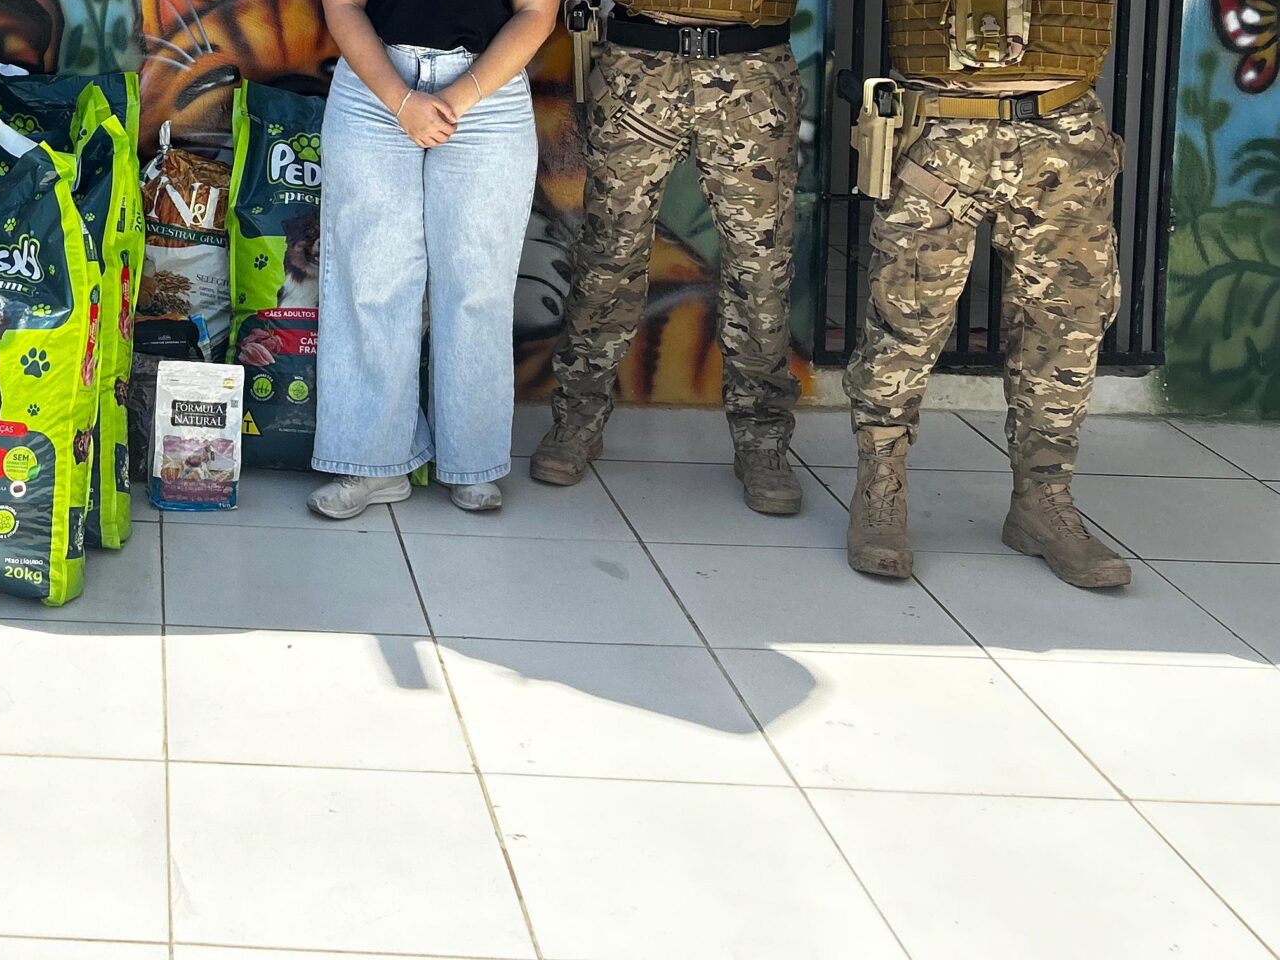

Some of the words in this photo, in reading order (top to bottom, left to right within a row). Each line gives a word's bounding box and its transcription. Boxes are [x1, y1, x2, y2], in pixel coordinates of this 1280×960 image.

[283, 310, 316, 318] ADULTOS
[175, 400, 224, 414] FÓRMULA
[174, 413, 224, 427] NATURAL
[244, 419, 253, 432] T
[12, 453, 29, 461] SEM
[4, 557, 19, 565] PESO
[20, 557, 44, 566] LÍQUIDO
[4, 565, 43, 584] 20kg
